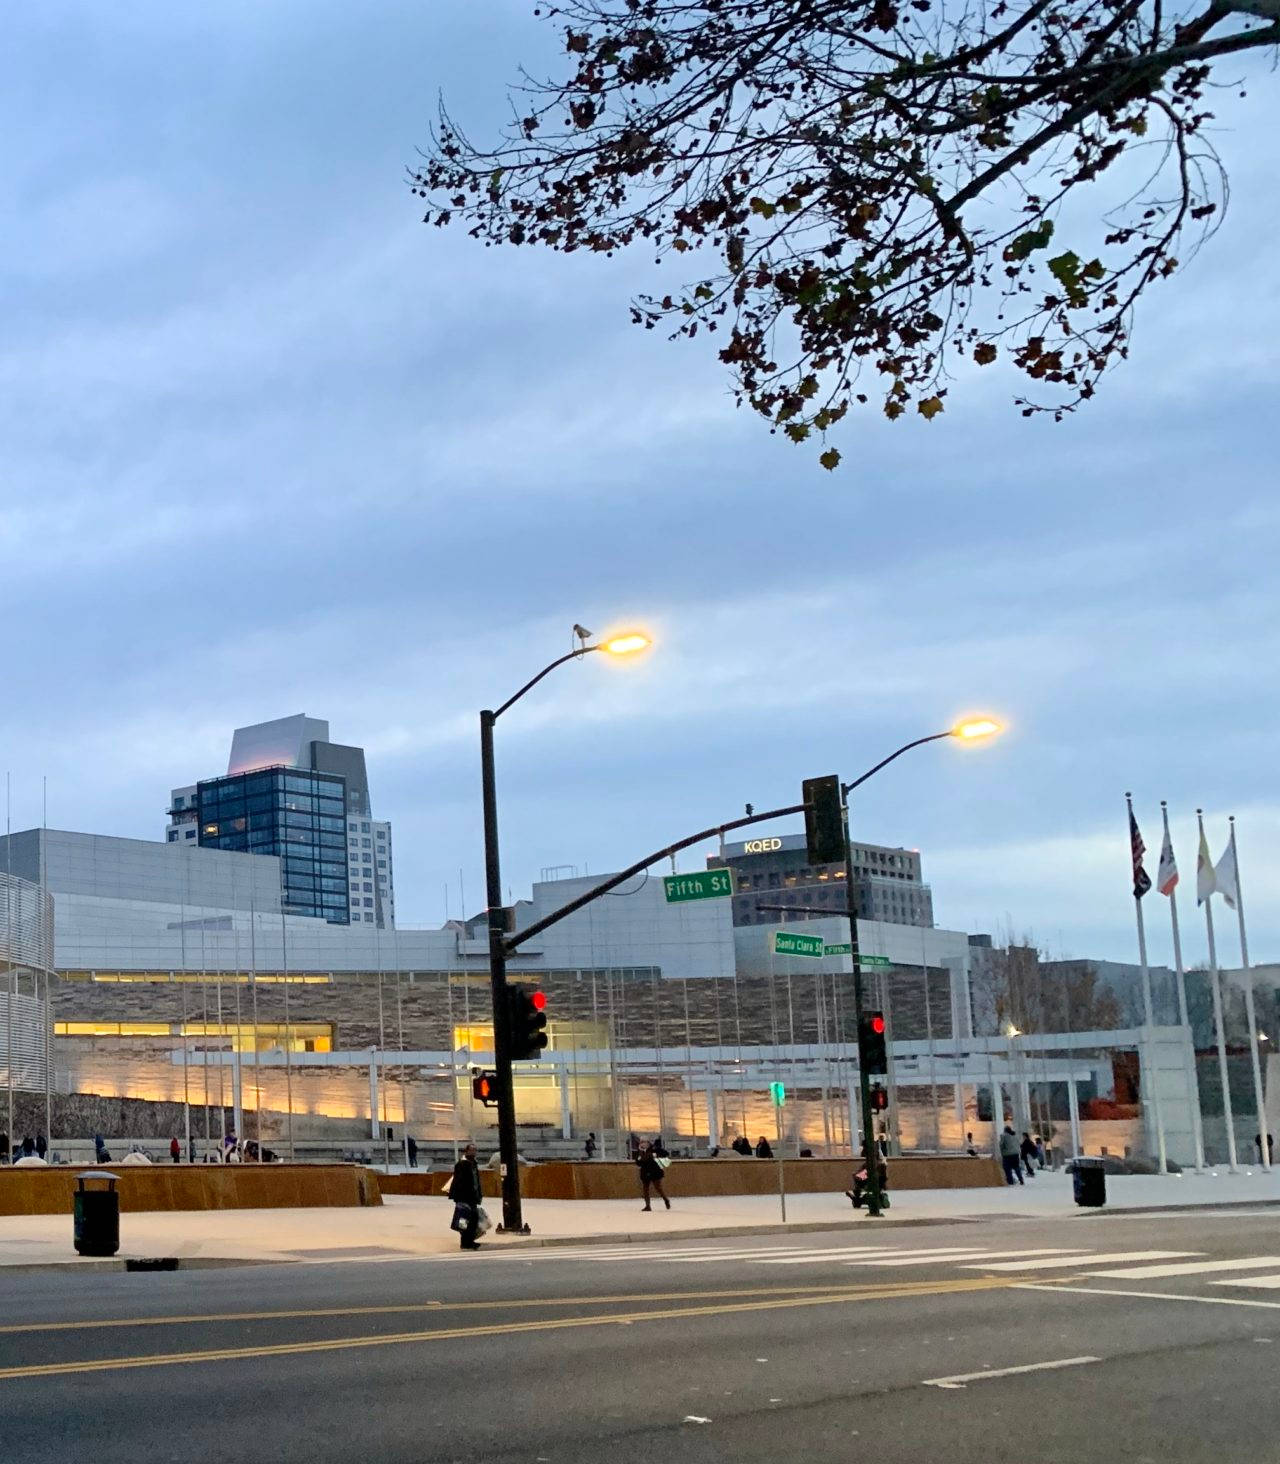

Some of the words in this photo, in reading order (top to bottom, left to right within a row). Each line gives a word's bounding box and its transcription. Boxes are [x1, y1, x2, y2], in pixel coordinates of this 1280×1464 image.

[744, 838, 781, 853] KQED
[666, 880, 704, 897] Fifth
[711, 876, 728, 891] St
[776, 938, 795, 950] Santa
[796, 940, 814, 952] Clara
[815, 942, 822, 953] St
